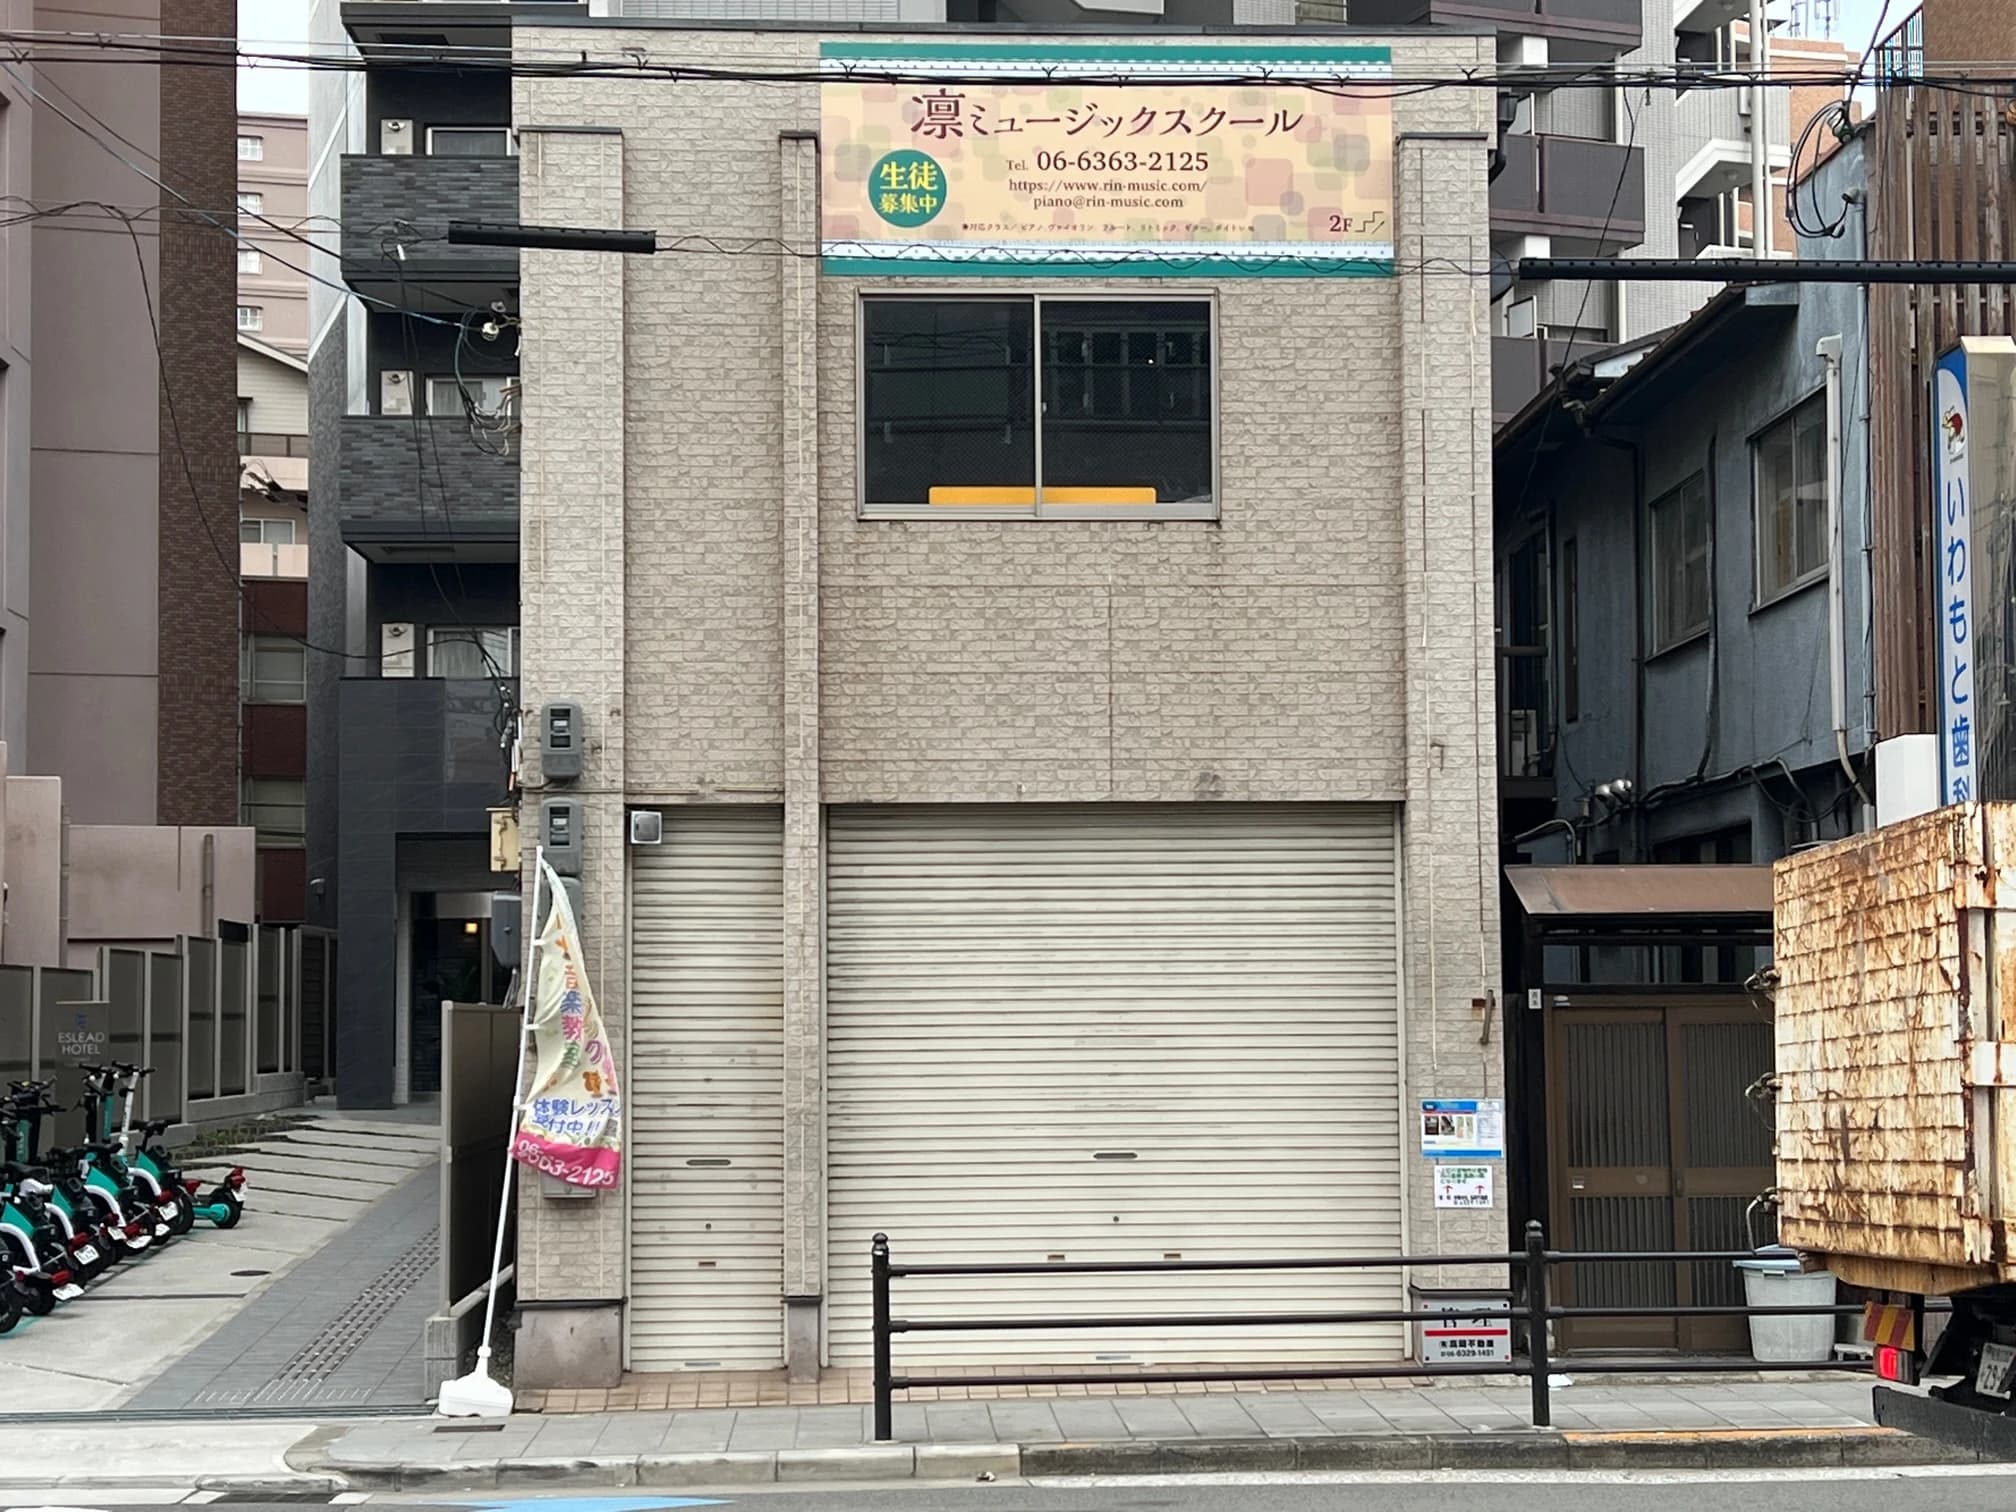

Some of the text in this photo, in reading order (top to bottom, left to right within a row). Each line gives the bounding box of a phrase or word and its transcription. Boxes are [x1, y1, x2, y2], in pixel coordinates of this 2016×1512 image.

[911, 88, 1303, 139] 凛ミュージックスクール
[1037, 150, 1209, 172] 06-6363-2125
[879, 161, 939, 191] 生徒
[1008, 178, 1208, 194] https://www.rin-music.com/
[878, 194, 939, 215] 募集中
[1033, 195, 1184, 210] piano@rin-music.com
[1329, 215, 1353, 232] 2F
[58, 1032, 105, 1044] ESLEAD
[62, 1043, 101, 1056] HOTEL
